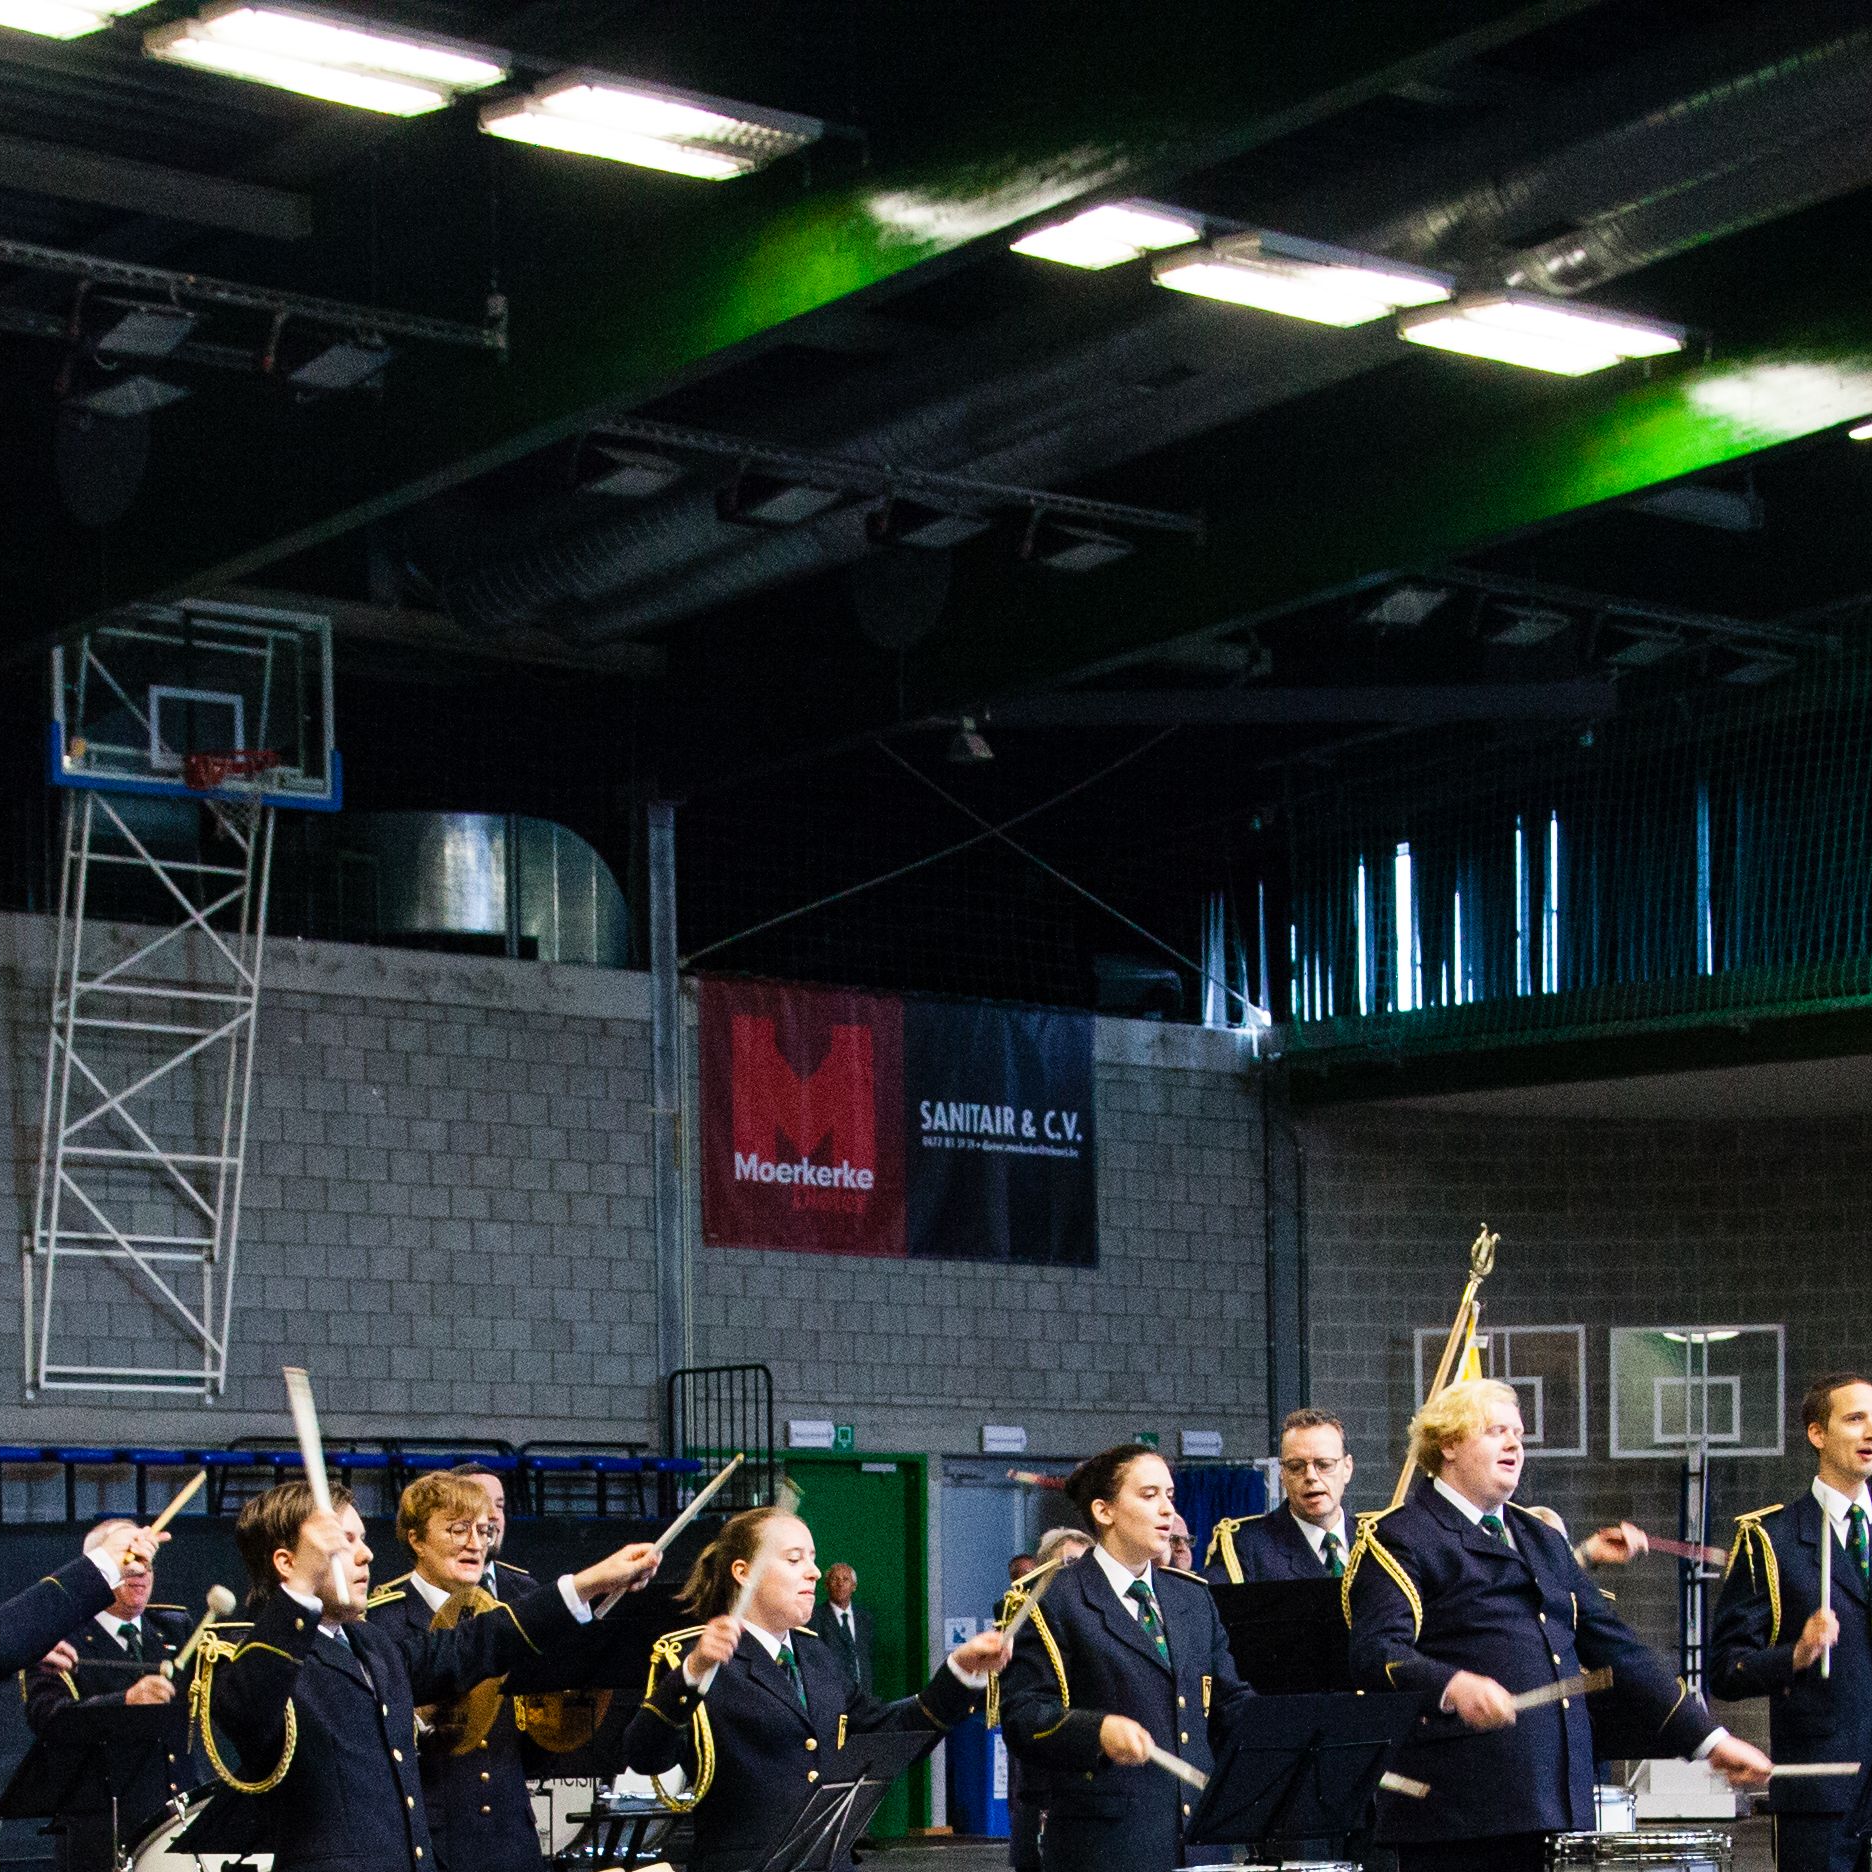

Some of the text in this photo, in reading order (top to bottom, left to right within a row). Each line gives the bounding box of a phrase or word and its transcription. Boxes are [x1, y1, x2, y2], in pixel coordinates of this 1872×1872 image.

[919, 1100, 1083, 1142] SANITAIR & C.V.
[734, 1152, 875, 1190] Moerkerke
